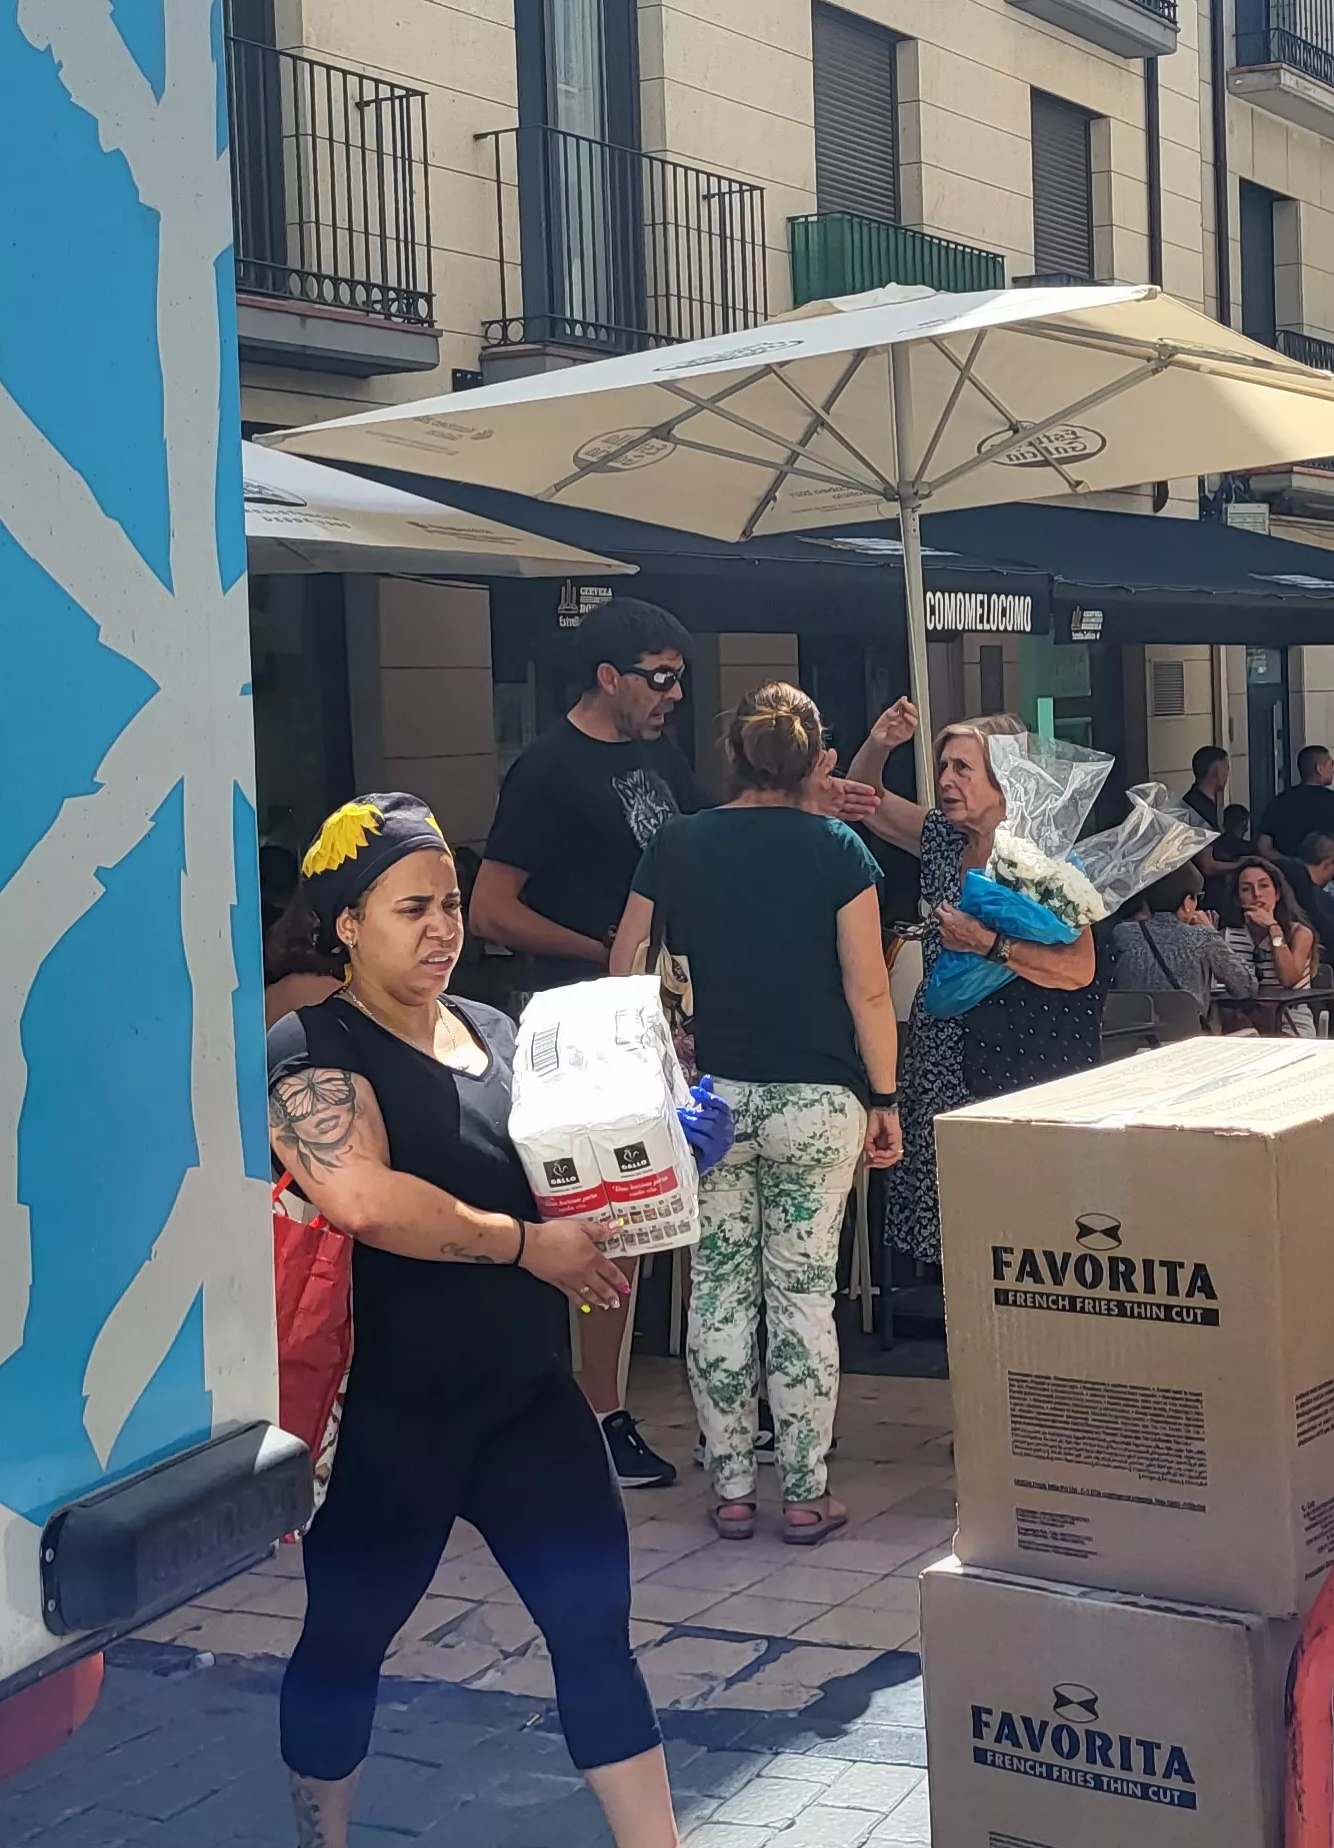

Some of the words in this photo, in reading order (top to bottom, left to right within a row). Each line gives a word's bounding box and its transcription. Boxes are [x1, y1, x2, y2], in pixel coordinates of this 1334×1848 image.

[925, 591, 1032, 632] COMOMELOCOMO
[550, 1176, 577, 1185] GALLO
[621, 1159, 647, 1170] GALLO
[991, 1245, 1219, 1300] FAVORITA
[1008, 1291, 1070, 1311] FRENCH
[1076, 1298, 1118, 1316] FRIES
[1124, 1302, 1165, 1319] THIN
[1171, 1307, 1203, 1323] CUT
[970, 1704, 1196, 1785] FAVORITA
[986, 1751, 1047, 1777] FRENCH
[1052, 1764, 1095, 1788] FRIES
[1100, 1775, 1142, 1798] THIN
[1148, 1786, 1181, 1806] CUT
